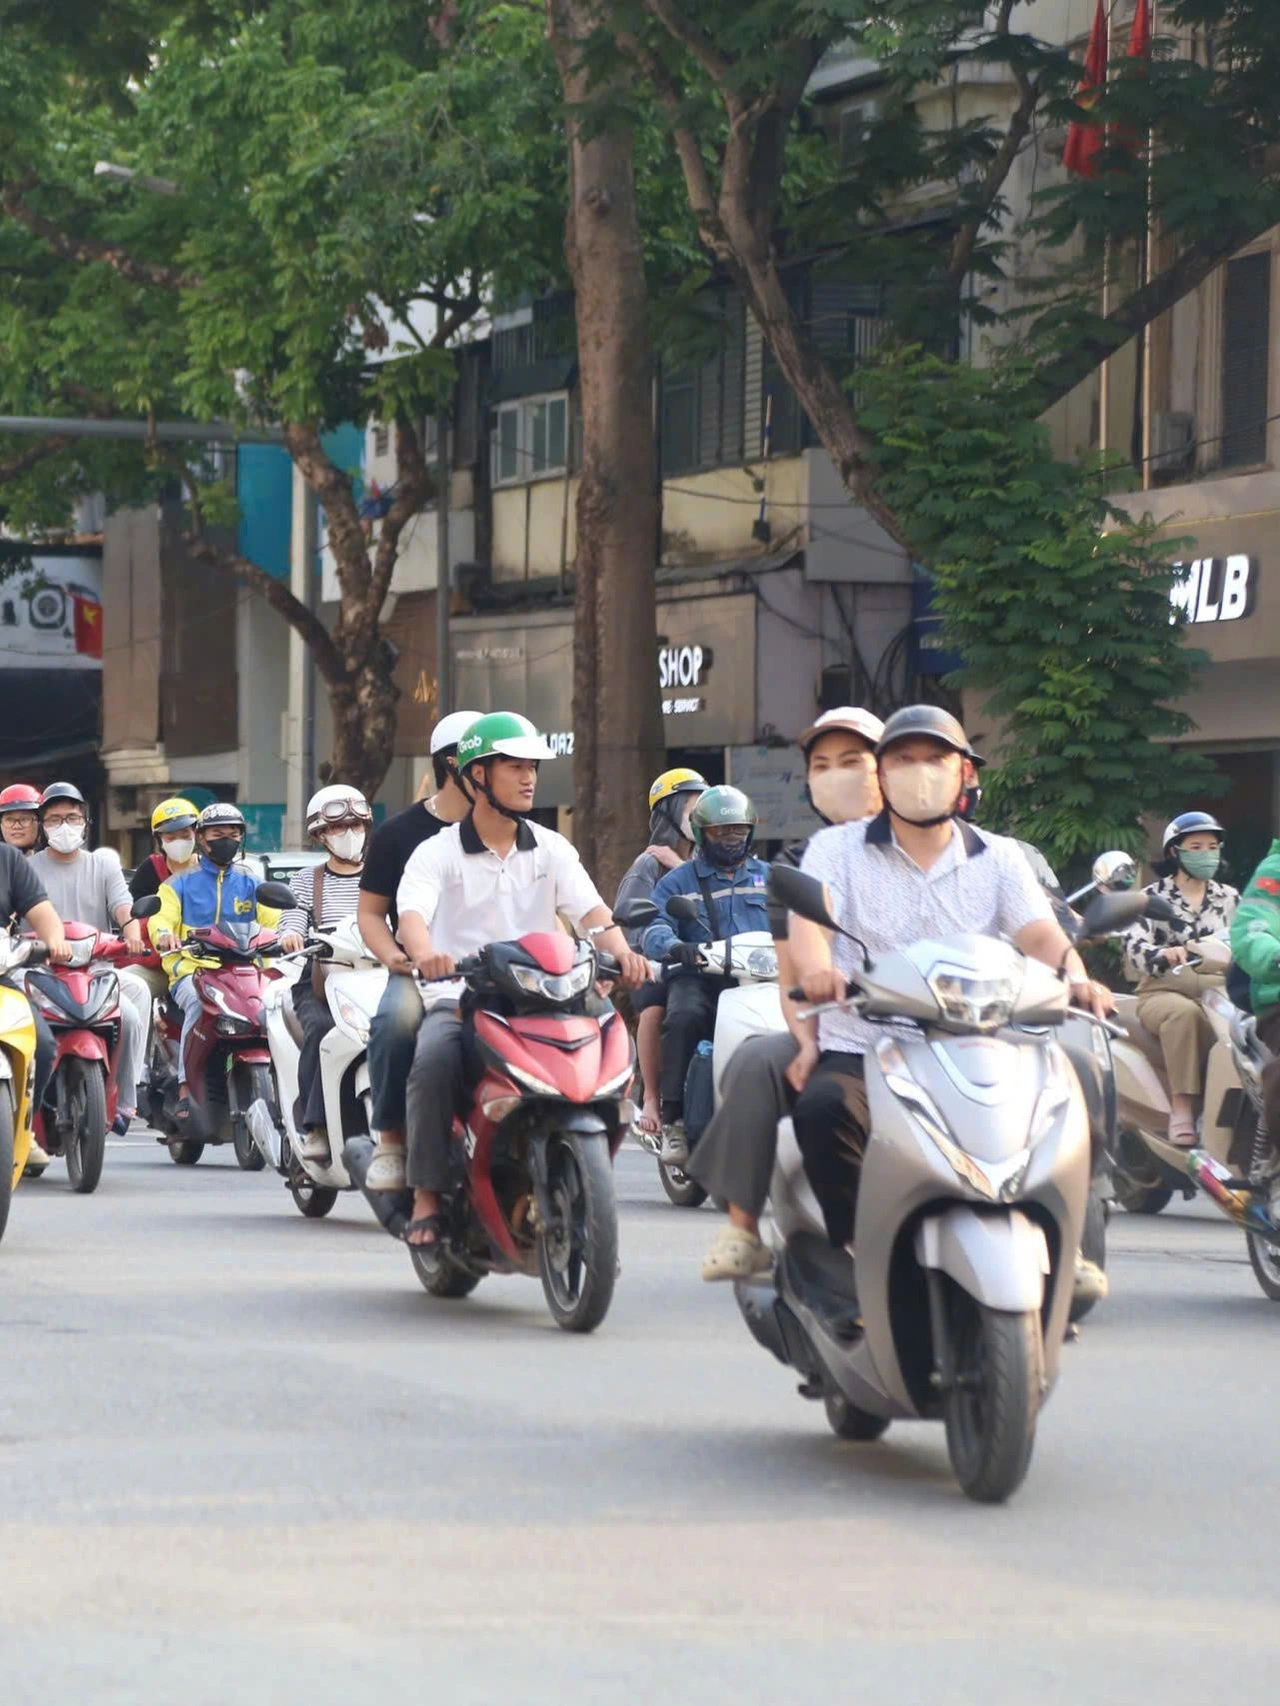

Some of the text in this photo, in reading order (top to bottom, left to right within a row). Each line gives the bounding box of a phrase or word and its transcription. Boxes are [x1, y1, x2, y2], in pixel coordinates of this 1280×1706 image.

[1168, 554, 1249, 625] MLB
[658, 645, 703, 688] SHOP
[459, 734, 483, 754] Grab
[233, 896, 253, 915] be
